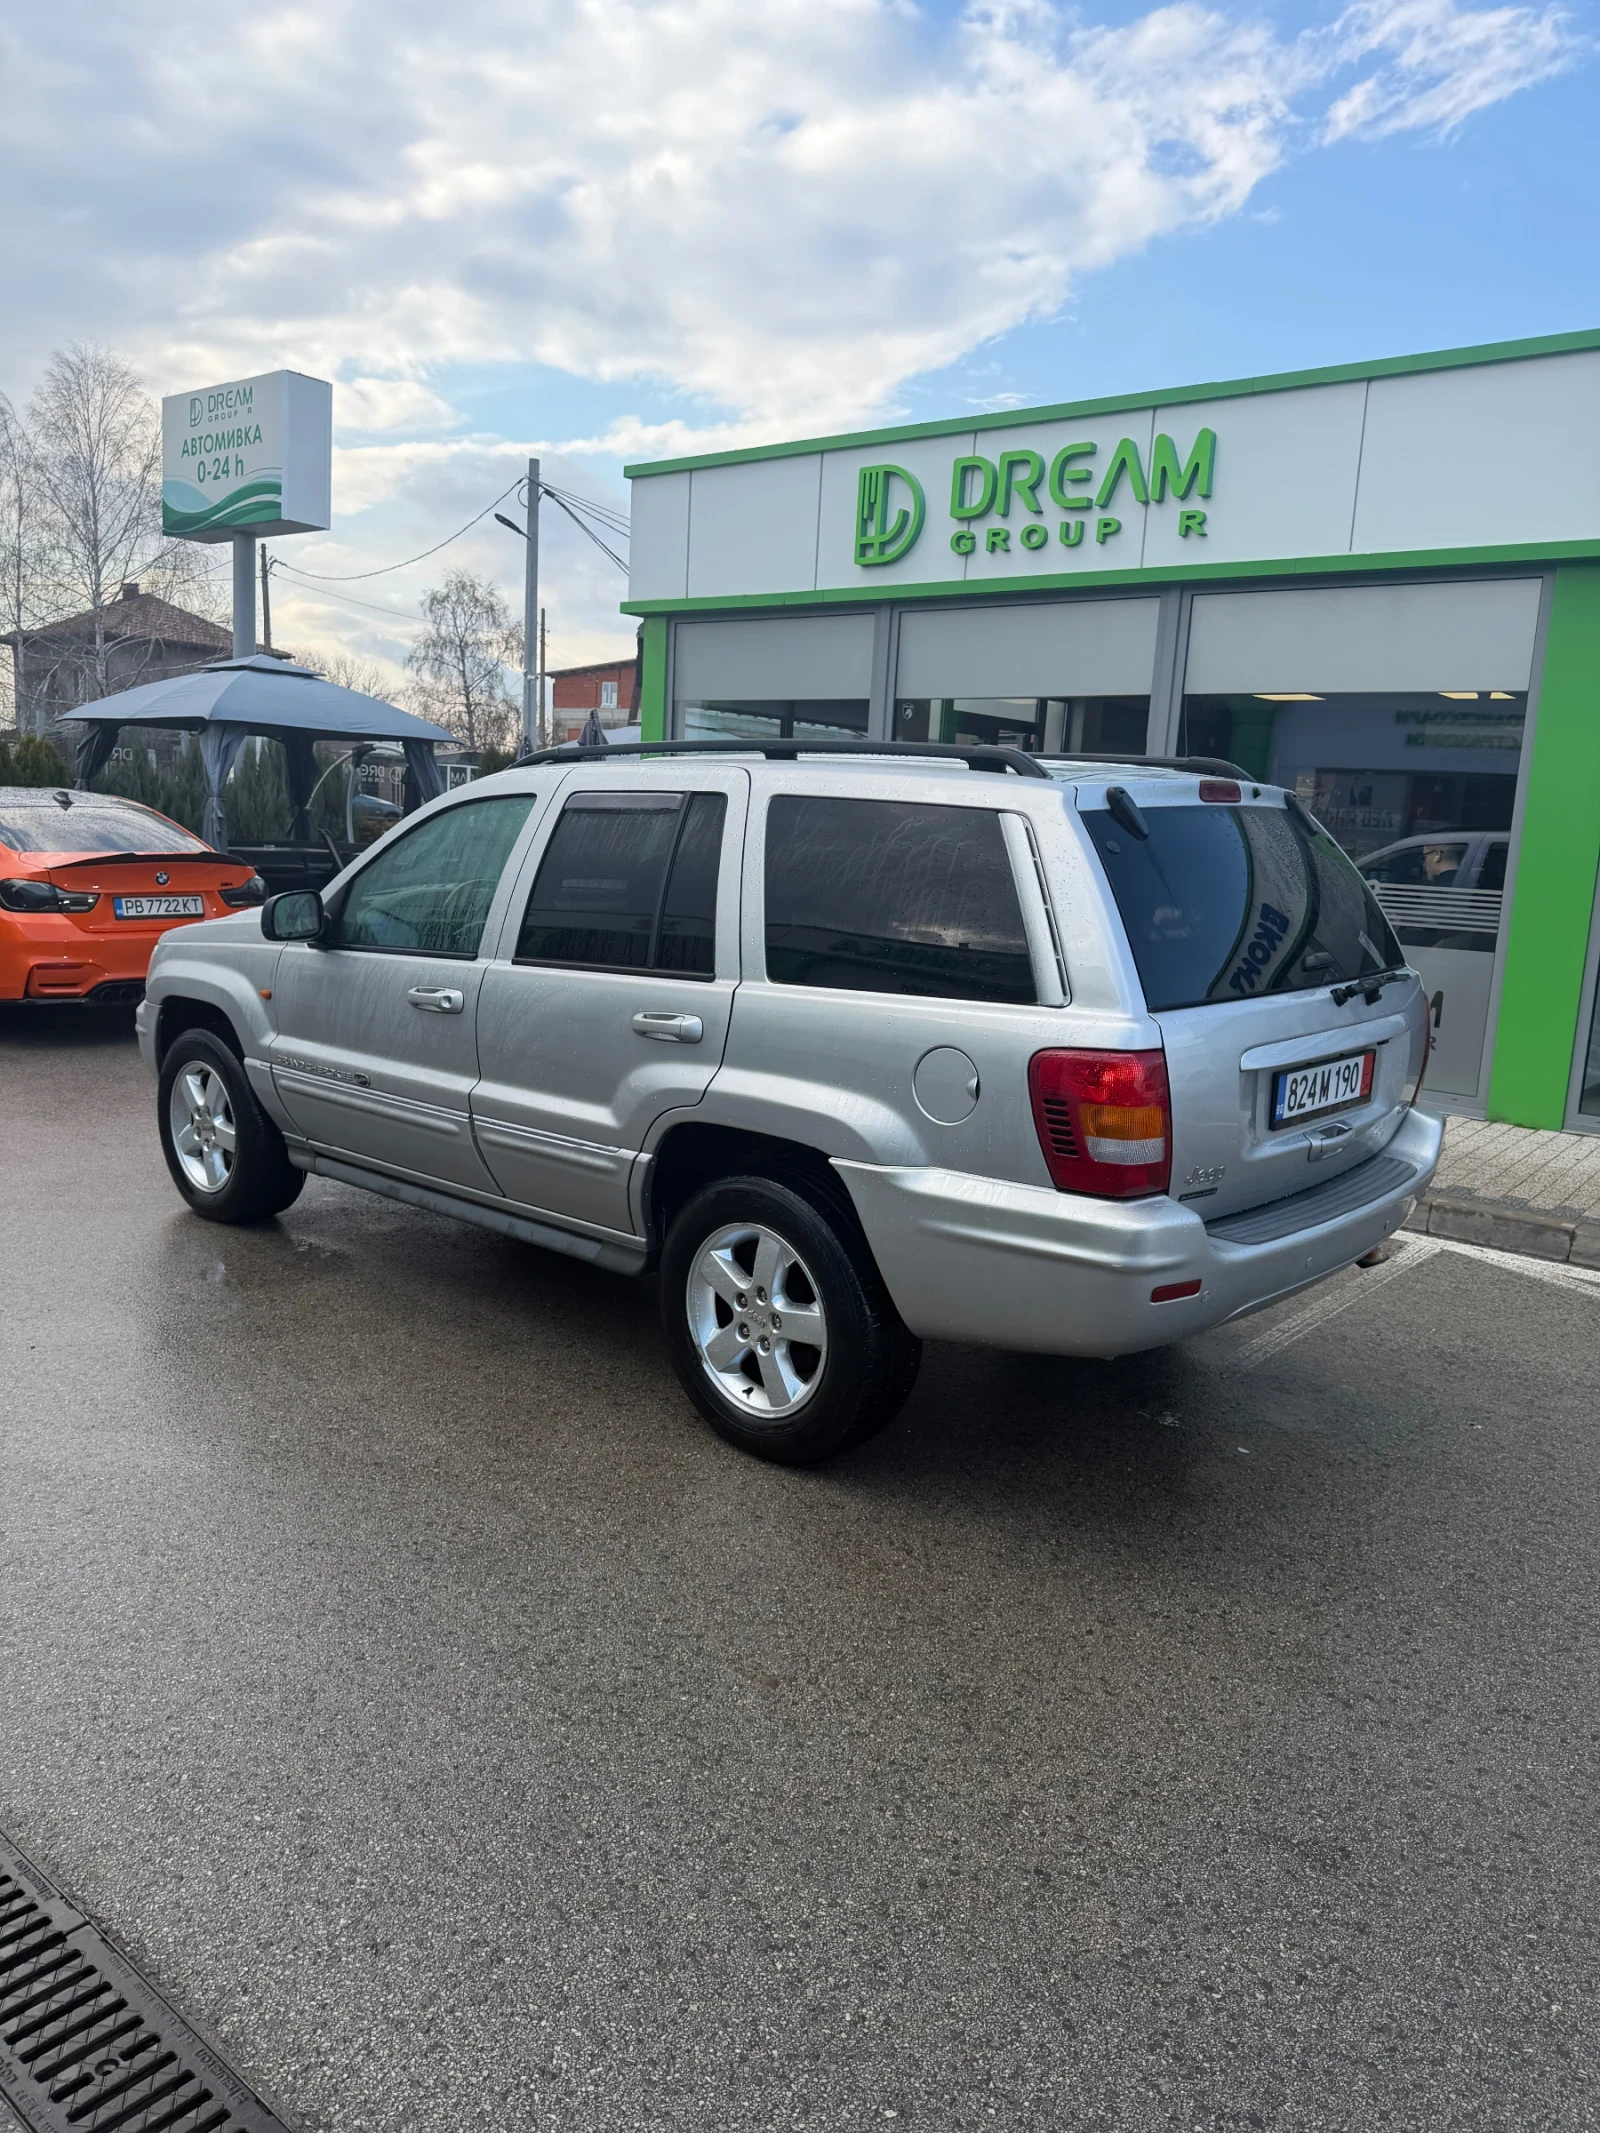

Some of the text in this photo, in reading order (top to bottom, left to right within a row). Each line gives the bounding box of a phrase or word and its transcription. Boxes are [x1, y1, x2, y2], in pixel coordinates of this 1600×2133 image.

[208, 386, 253, 413] DREAM
[208, 407, 253, 422] GROUP R
[181, 424, 263, 458] АВТОМИВКА
[197, 454, 244, 483] 0-24 h
[950, 428, 1216, 520] DREAM
[950, 510, 1207, 555] GROUP R
[1184, 1165, 1225, 1187] Jeep
